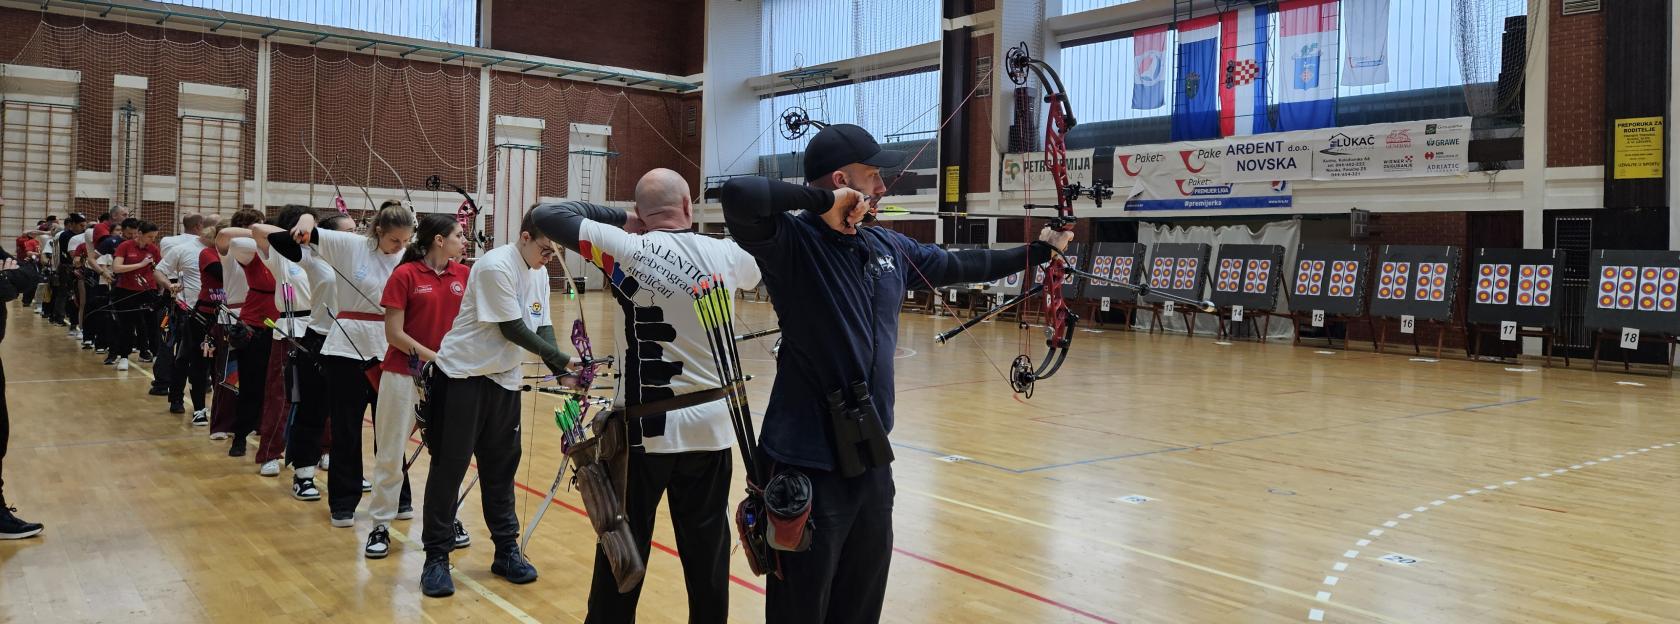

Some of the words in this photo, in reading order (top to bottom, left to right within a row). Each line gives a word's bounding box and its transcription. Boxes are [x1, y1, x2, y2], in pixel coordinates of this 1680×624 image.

[1337, 134, 1374, 147] LUKAČ
[1226, 140, 1284, 156] ARĐENT
[1198, 149, 1222, 159] Pake
[1236, 157, 1297, 172] NOVSKA
[626, 266, 674, 298] streličari
[1166, 304, 1173, 312] 13
[1402, 320, 1412, 328] 16
[1503, 326, 1514, 335] 17
[1624, 332, 1637, 343] 18
